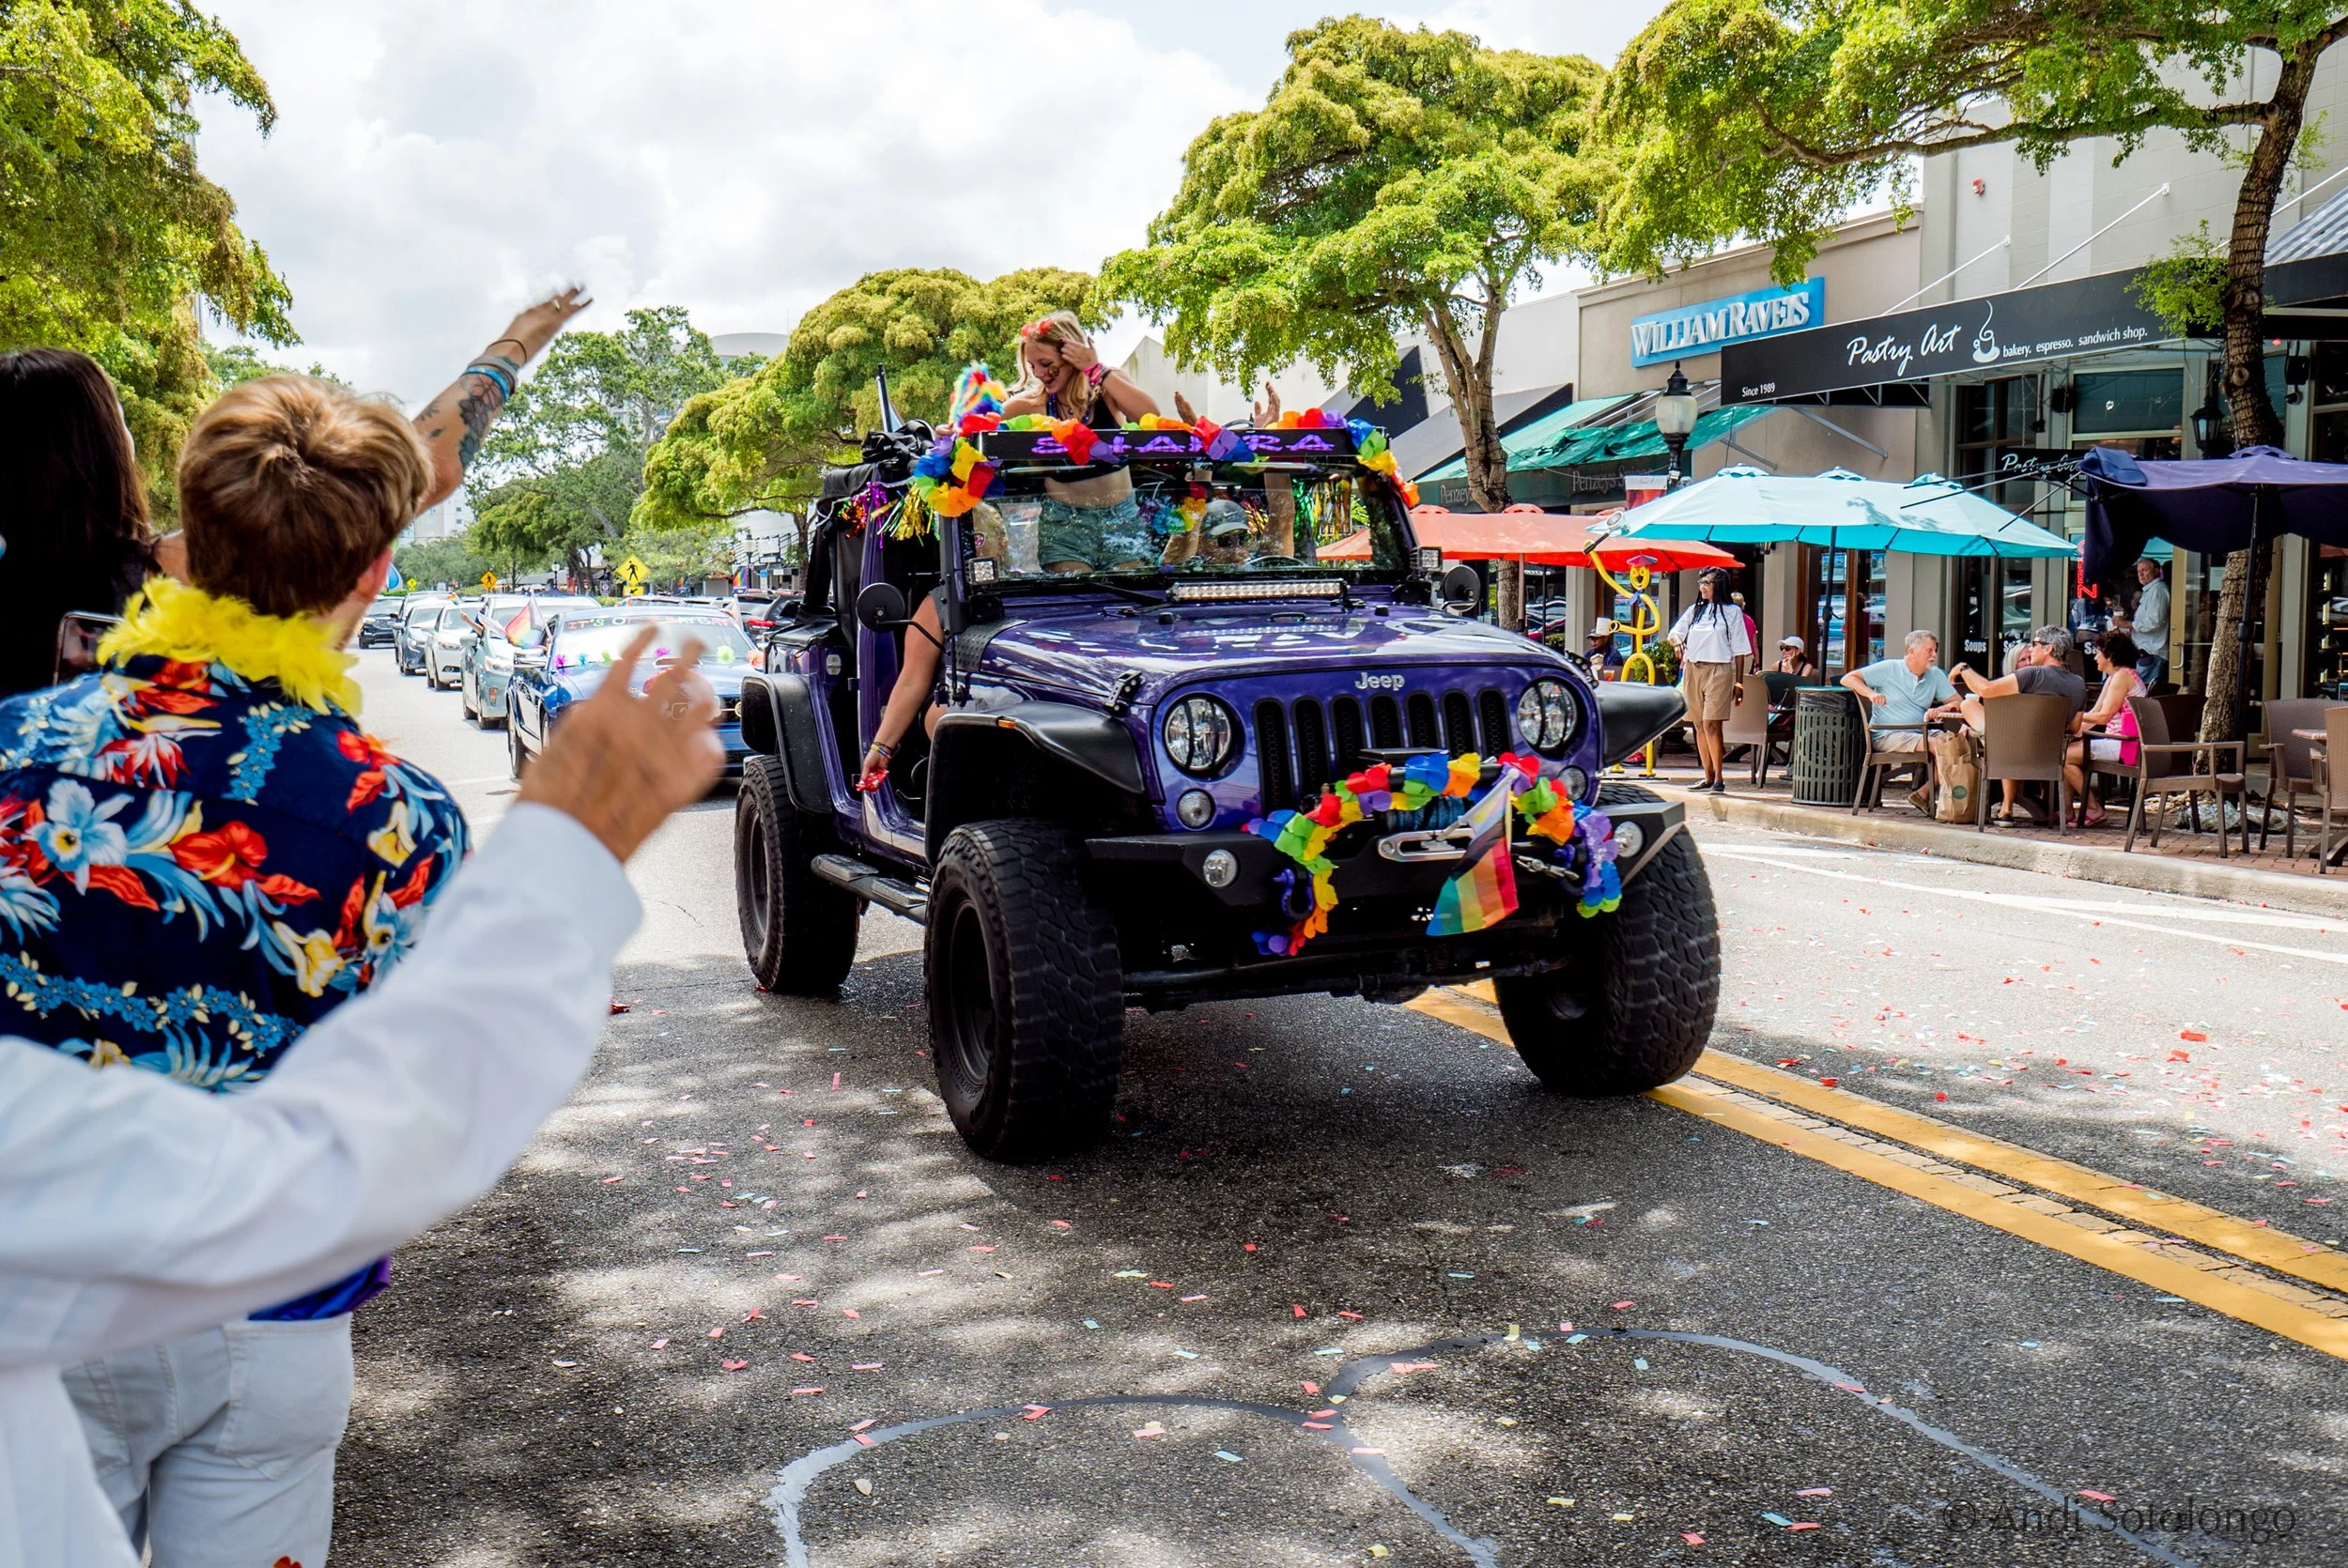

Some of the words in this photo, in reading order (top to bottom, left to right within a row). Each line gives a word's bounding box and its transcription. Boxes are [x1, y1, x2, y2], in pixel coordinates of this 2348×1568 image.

[1630, 308, 1730, 358] WILLIAM
[1728, 292, 1810, 338] RAVEIS
[1846, 333, 1913, 377] Pastry
[1921, 324, 1961, 356] Art
[2002, 343, 2031, 358] bakery.
[2036, 338, 2074, 355] espresso.
[2078, 330, 2121, 346] sandwich
[2123, 325, 2148, 341] shop.
[1741, 383, 1759, 397] Since
[1759, 382, 1776, 394] 1989
[1572, 469, 1616, 494] Penzeys
[568, 618, 604, 630] IT'S
[1964, 639, 1986, 653] Soups
[1354, 672, 1405, 691] Jeep
